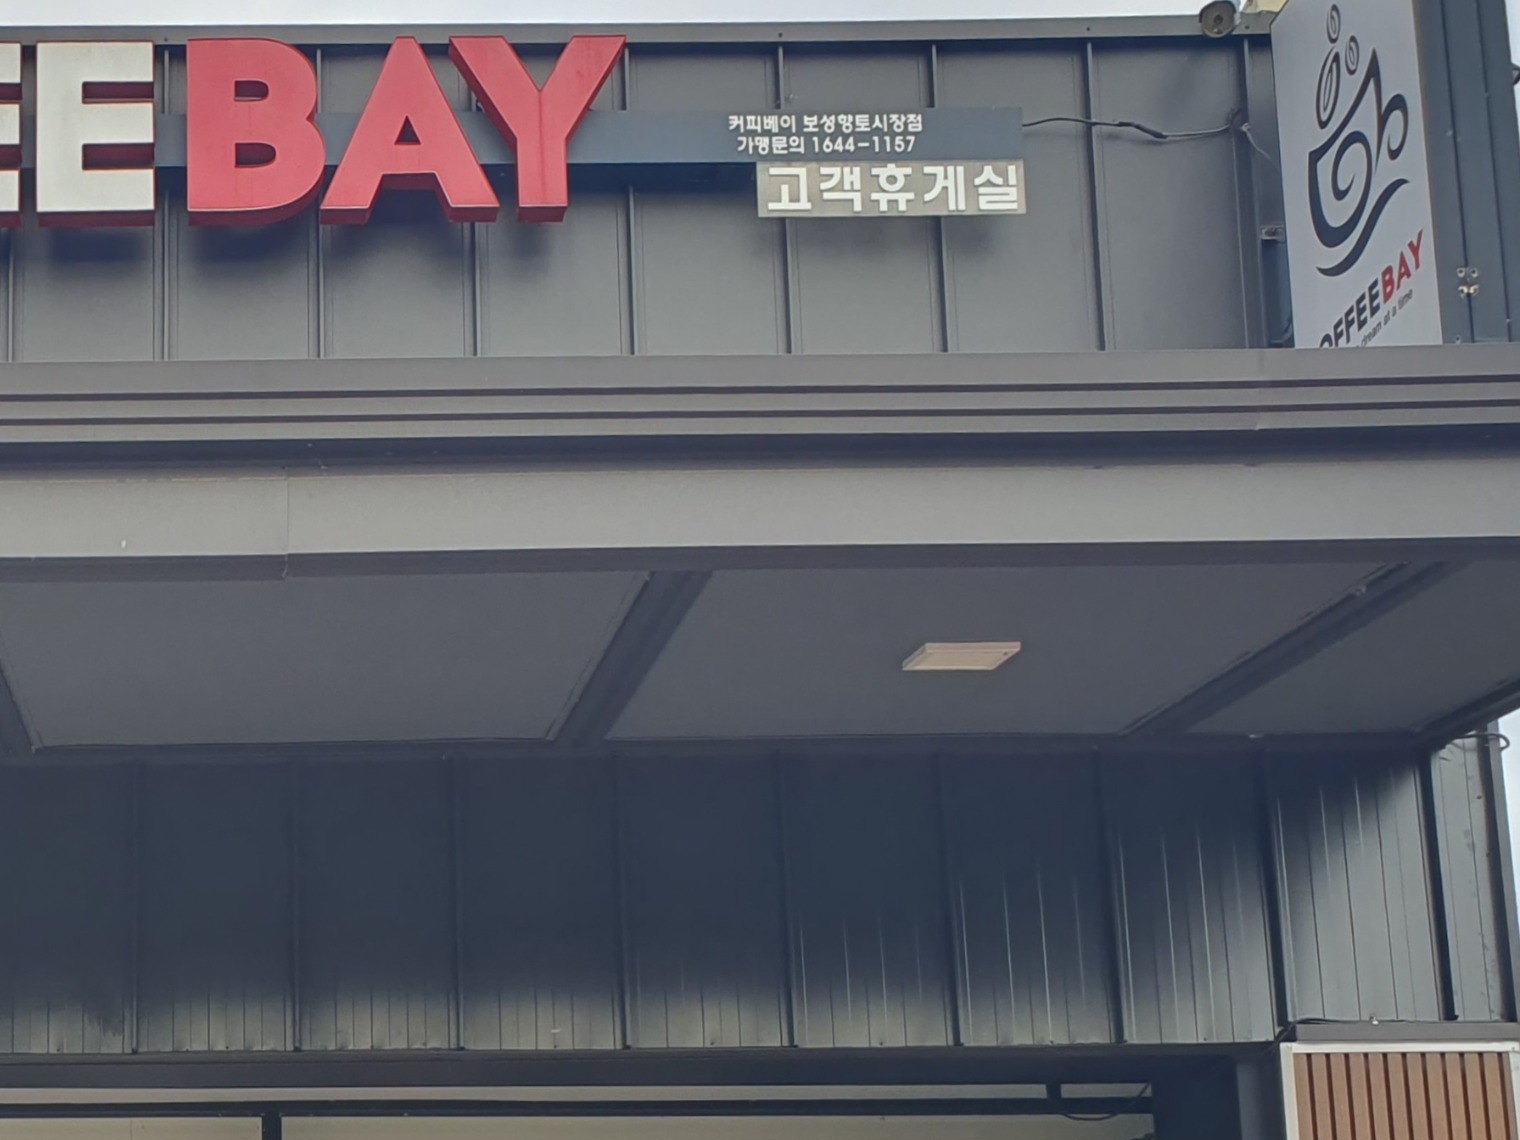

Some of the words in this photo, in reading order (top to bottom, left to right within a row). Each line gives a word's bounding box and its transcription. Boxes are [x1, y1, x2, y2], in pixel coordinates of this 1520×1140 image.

[728, 115, 796, 133] 커피베이
[803, 113, 923, 133] 보성향토시장점
[737, 136, 805, 155] 가맹문의
[812, 136, 916, 153] 1644-1157
[767, 163, 1019, 212] 고객휴게실
